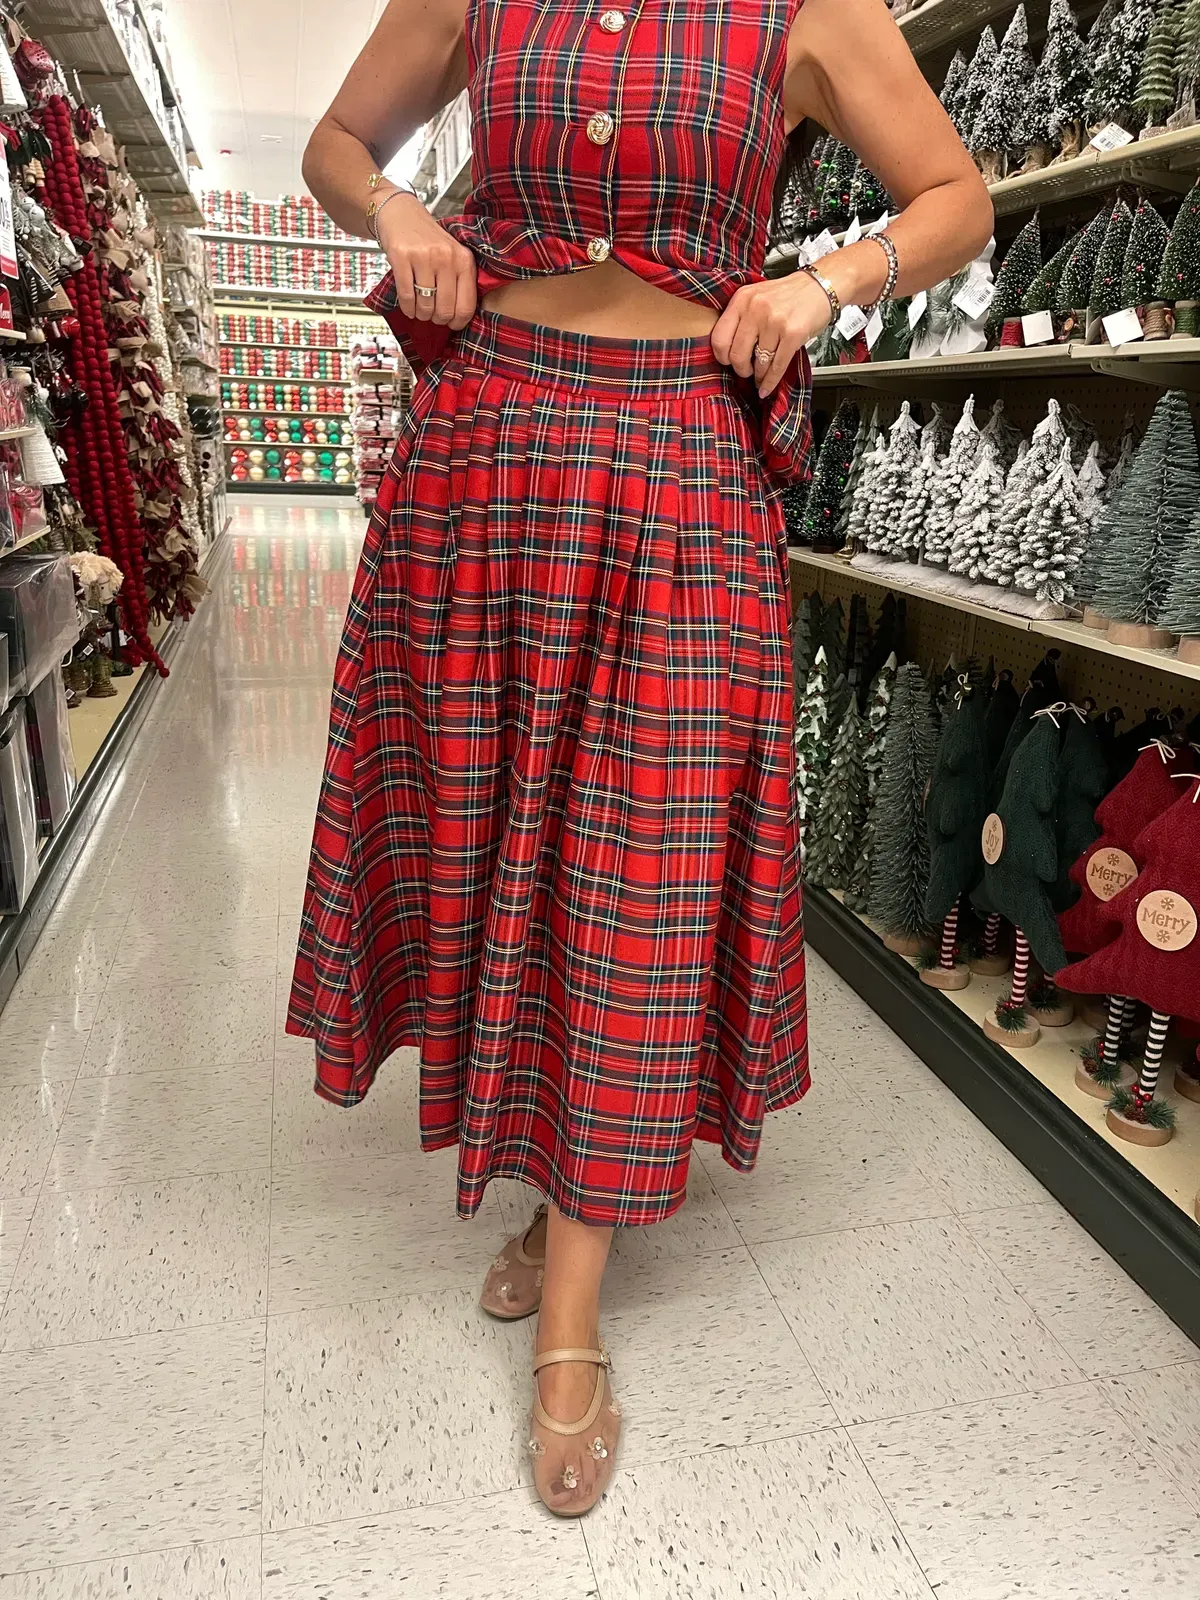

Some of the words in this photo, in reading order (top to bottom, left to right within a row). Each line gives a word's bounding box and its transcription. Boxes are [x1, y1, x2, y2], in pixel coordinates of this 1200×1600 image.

[986, 829, 999, 852] Joy
[1090, 863, 1133, 888] Merry
[1142, 907, 1191, 935] Merry
